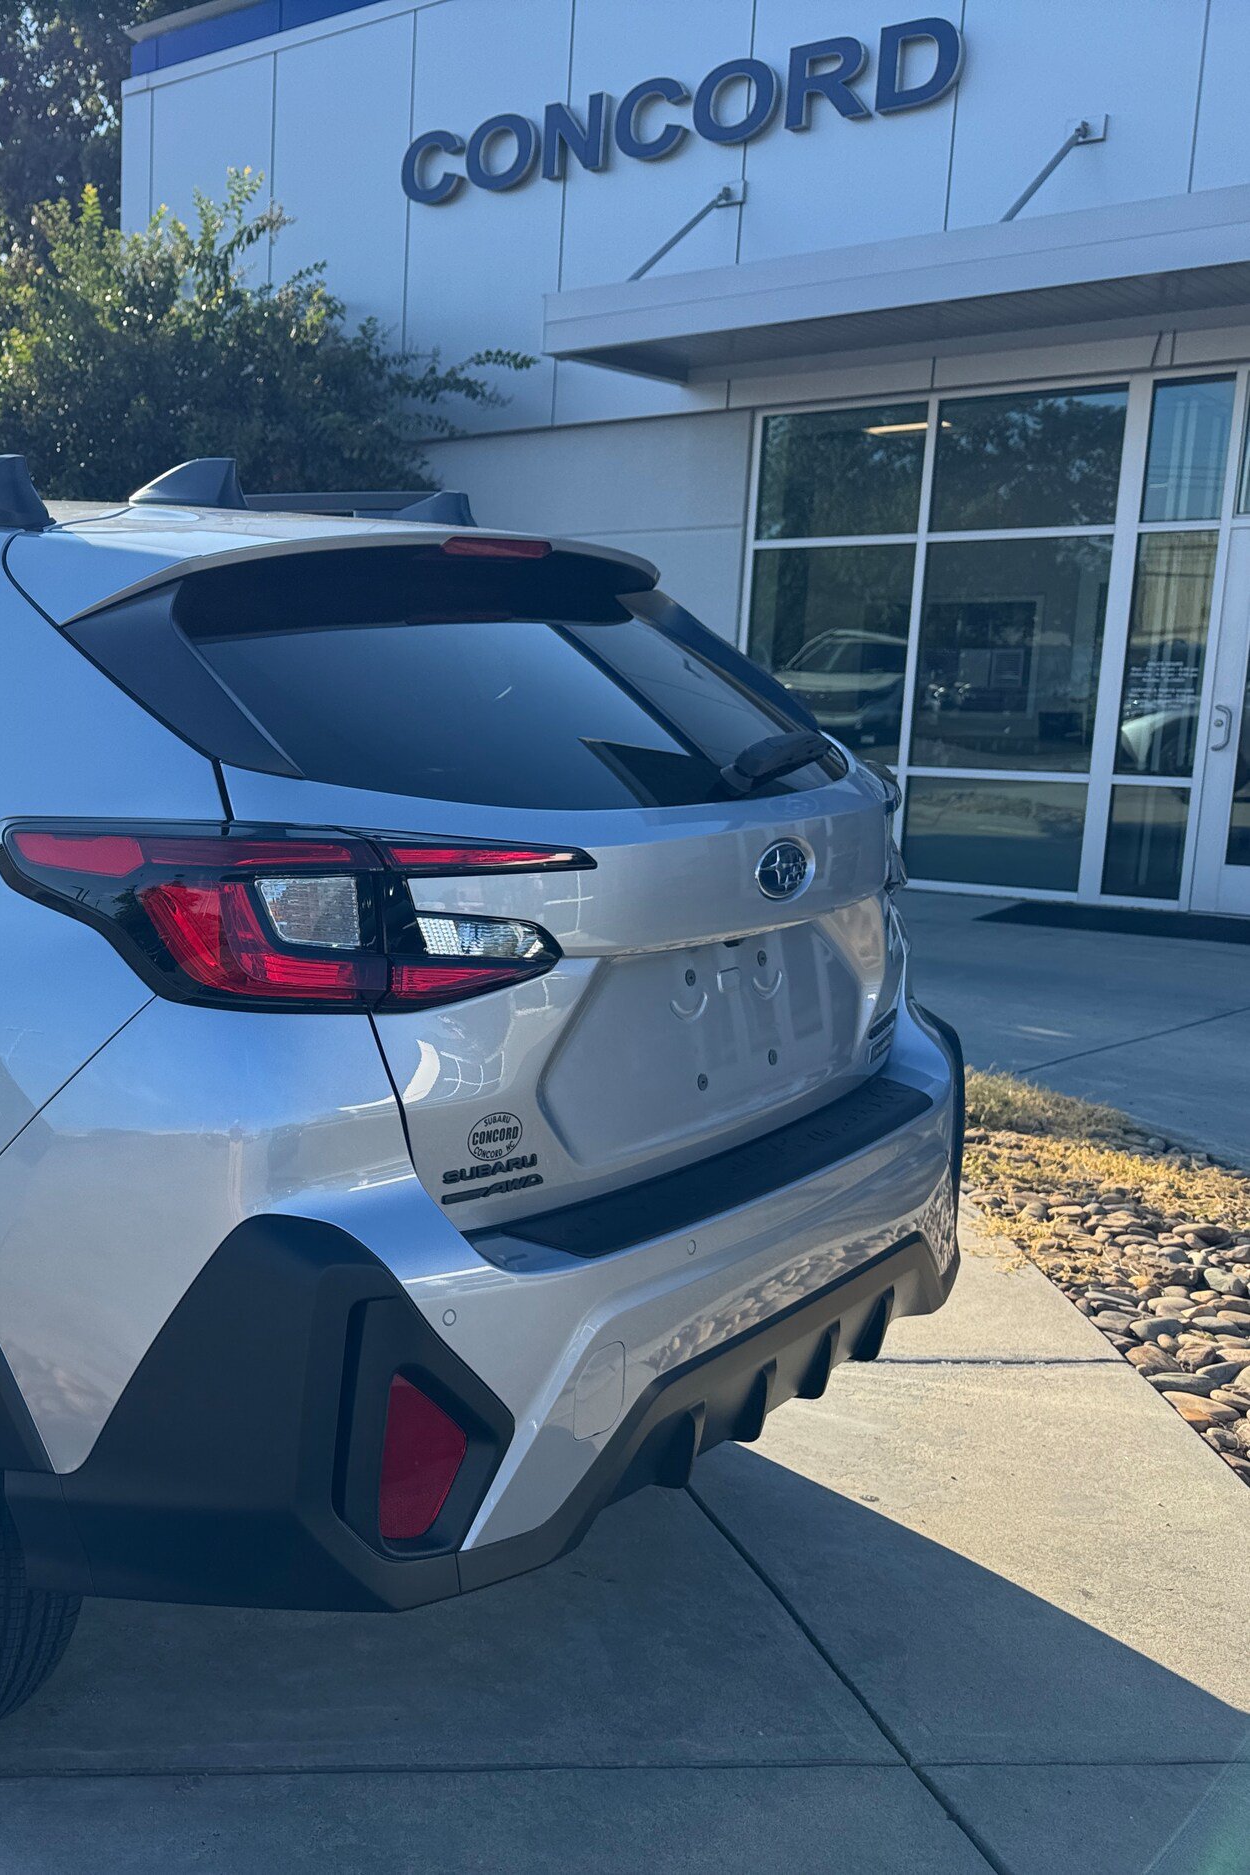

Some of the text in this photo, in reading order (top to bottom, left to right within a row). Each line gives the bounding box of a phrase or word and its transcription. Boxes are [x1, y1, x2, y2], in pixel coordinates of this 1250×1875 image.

[401, 17, 966, 205] CONCORD
[483, 1115, 511, 1127] SUBARU
[472, 1126, 519, 1146] CONCORD
[473, 1146, 503, 1159] CONCORD
[442, 1153, 538, 1184] SUBARU
[481, 1173, 544, 1197] AWD
